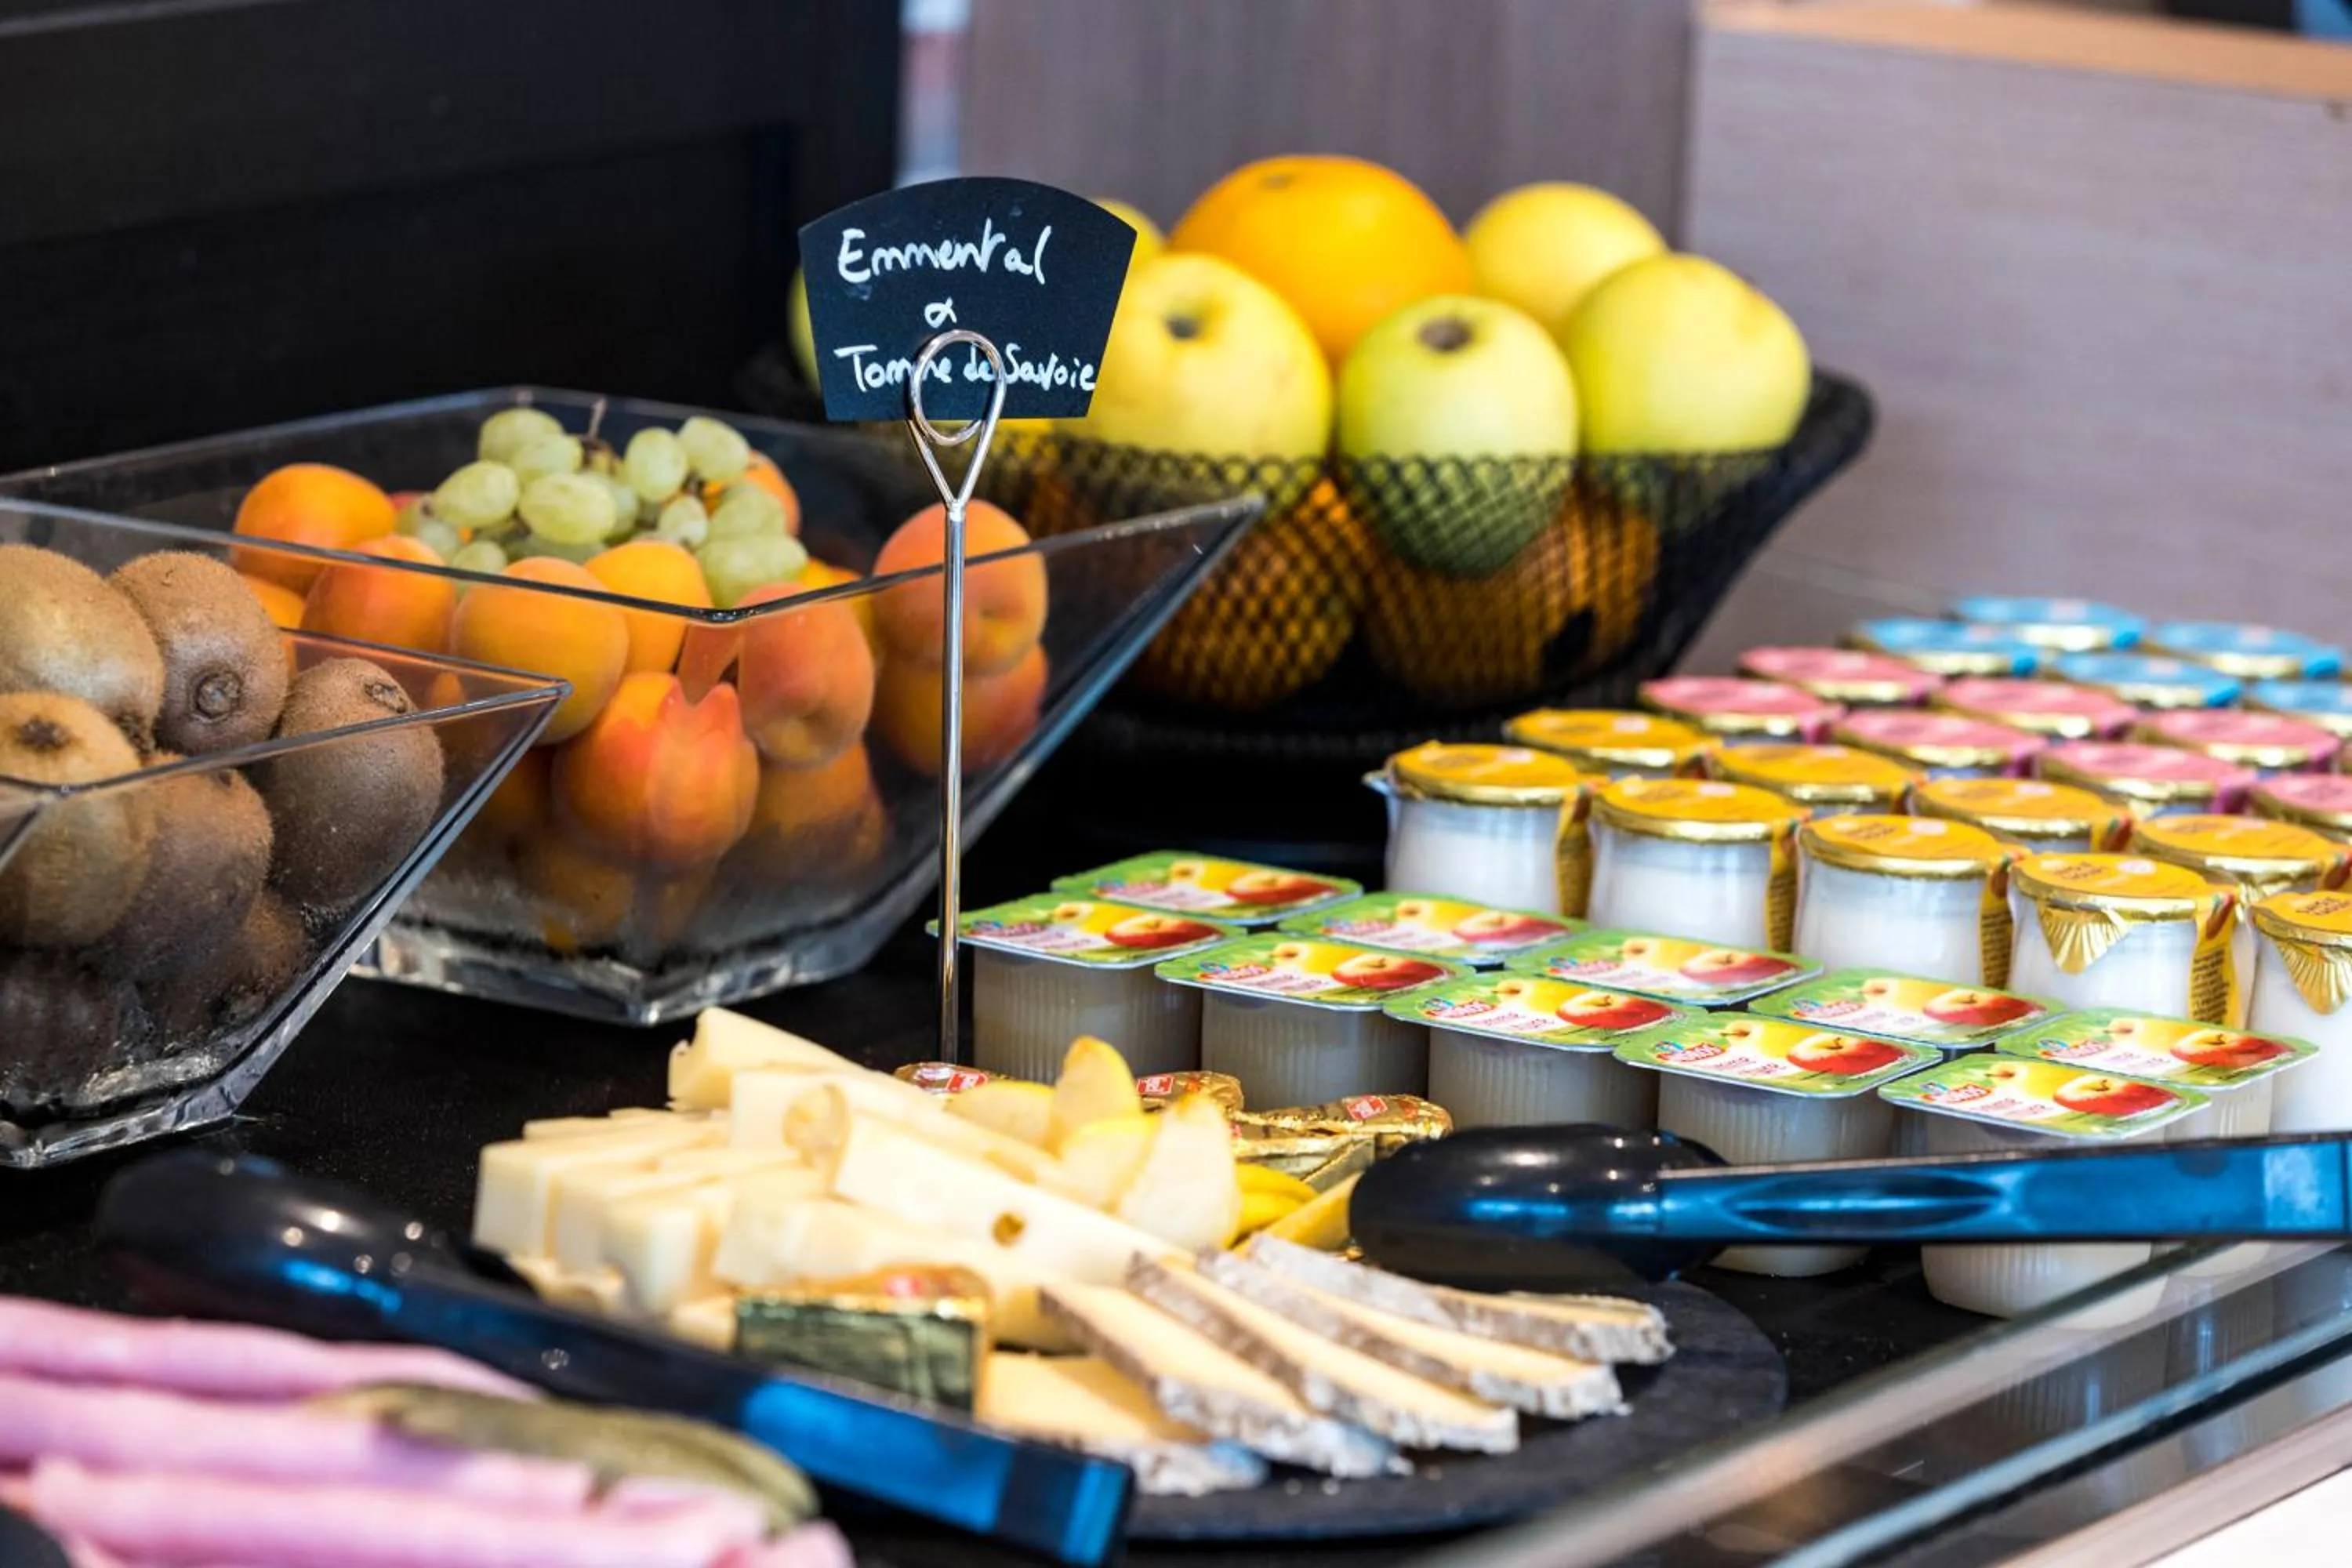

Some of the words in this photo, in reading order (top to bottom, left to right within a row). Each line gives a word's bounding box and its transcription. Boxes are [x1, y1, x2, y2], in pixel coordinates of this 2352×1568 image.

[837, 216, 1052, 285] Emmental
[962, 342, 998, 383] de
[1003, 342, 1096, 392] Savoie
